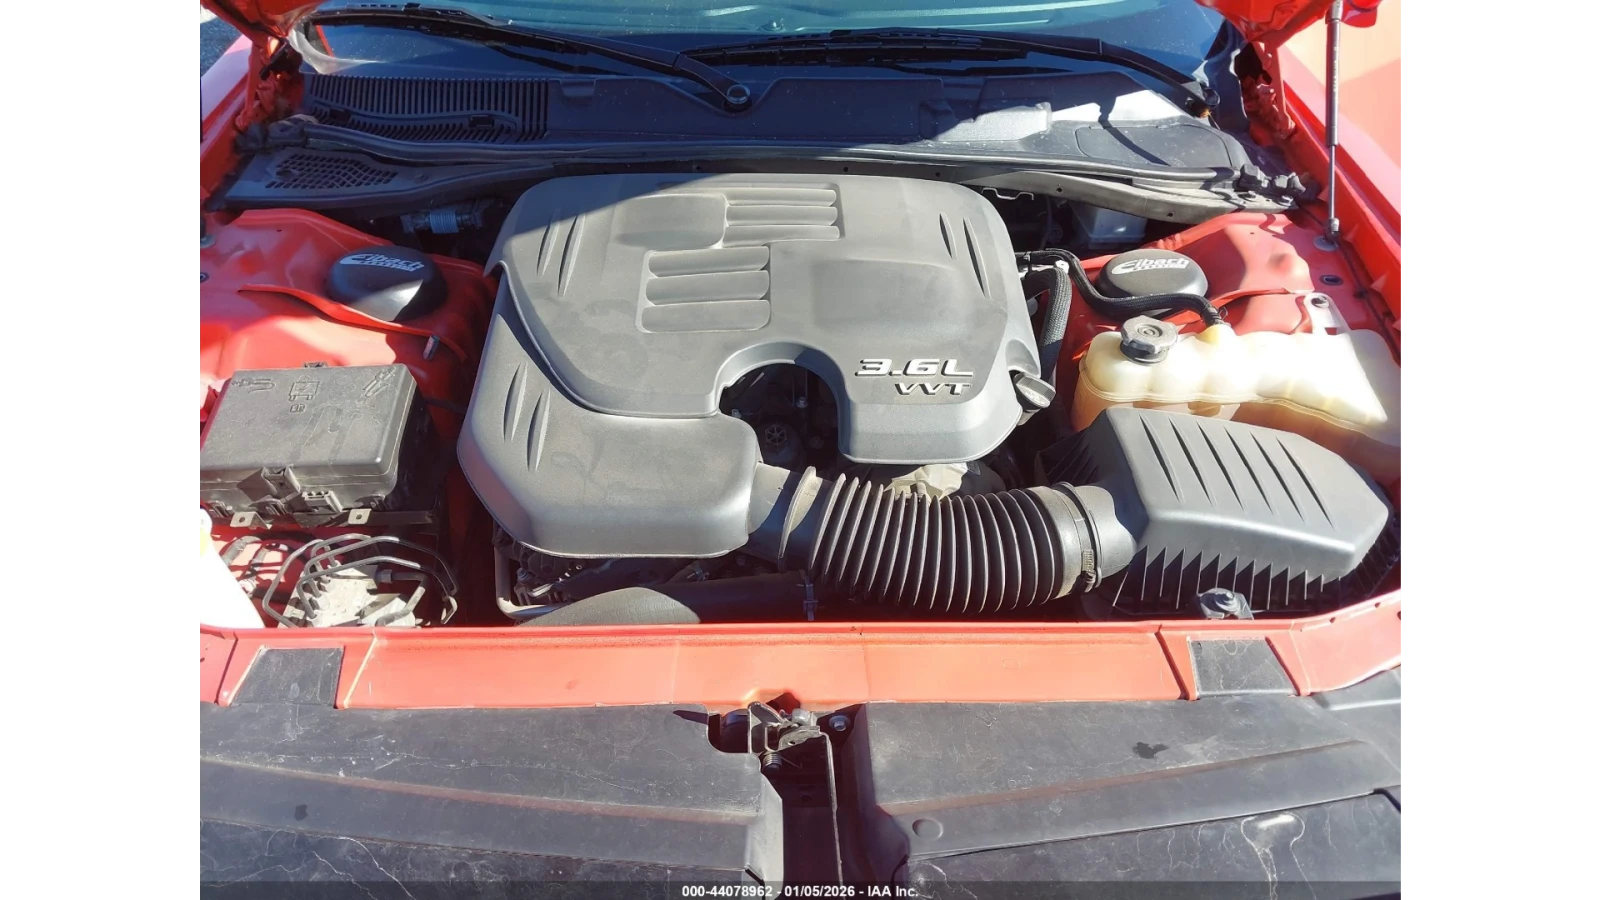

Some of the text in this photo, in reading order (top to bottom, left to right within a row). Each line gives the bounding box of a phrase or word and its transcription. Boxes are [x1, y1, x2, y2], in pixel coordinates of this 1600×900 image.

[340, 254, 425, 272] Eibach
[1111, 258, 1190, 275] Eibach
[854, 358, 974, 377] 3.6L
[894, 382, 972, 396] VVT
